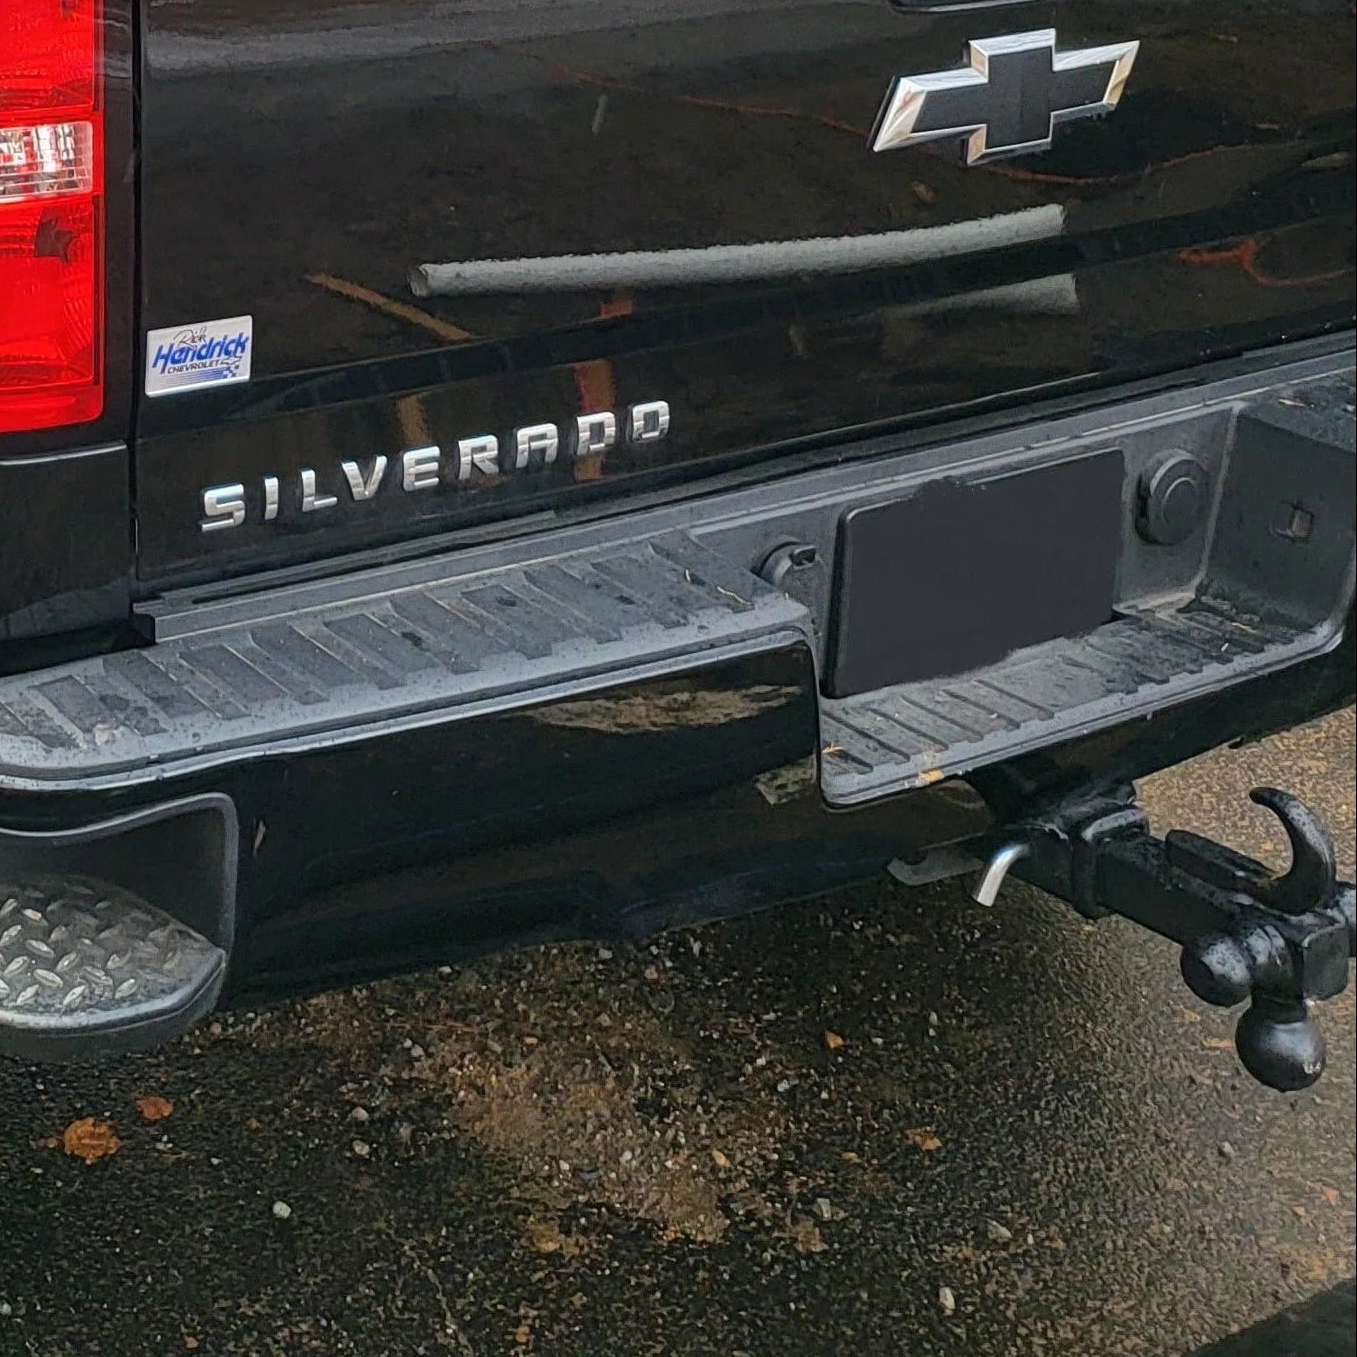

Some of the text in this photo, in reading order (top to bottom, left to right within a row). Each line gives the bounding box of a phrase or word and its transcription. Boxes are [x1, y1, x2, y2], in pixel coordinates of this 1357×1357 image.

[151, 331, 250, 374] Hendrick
[173, 325, 208, 349] Rick
[167, 358, 221, 375] CHEVROLET
[200, 399, 670, 532] SILVERADO
